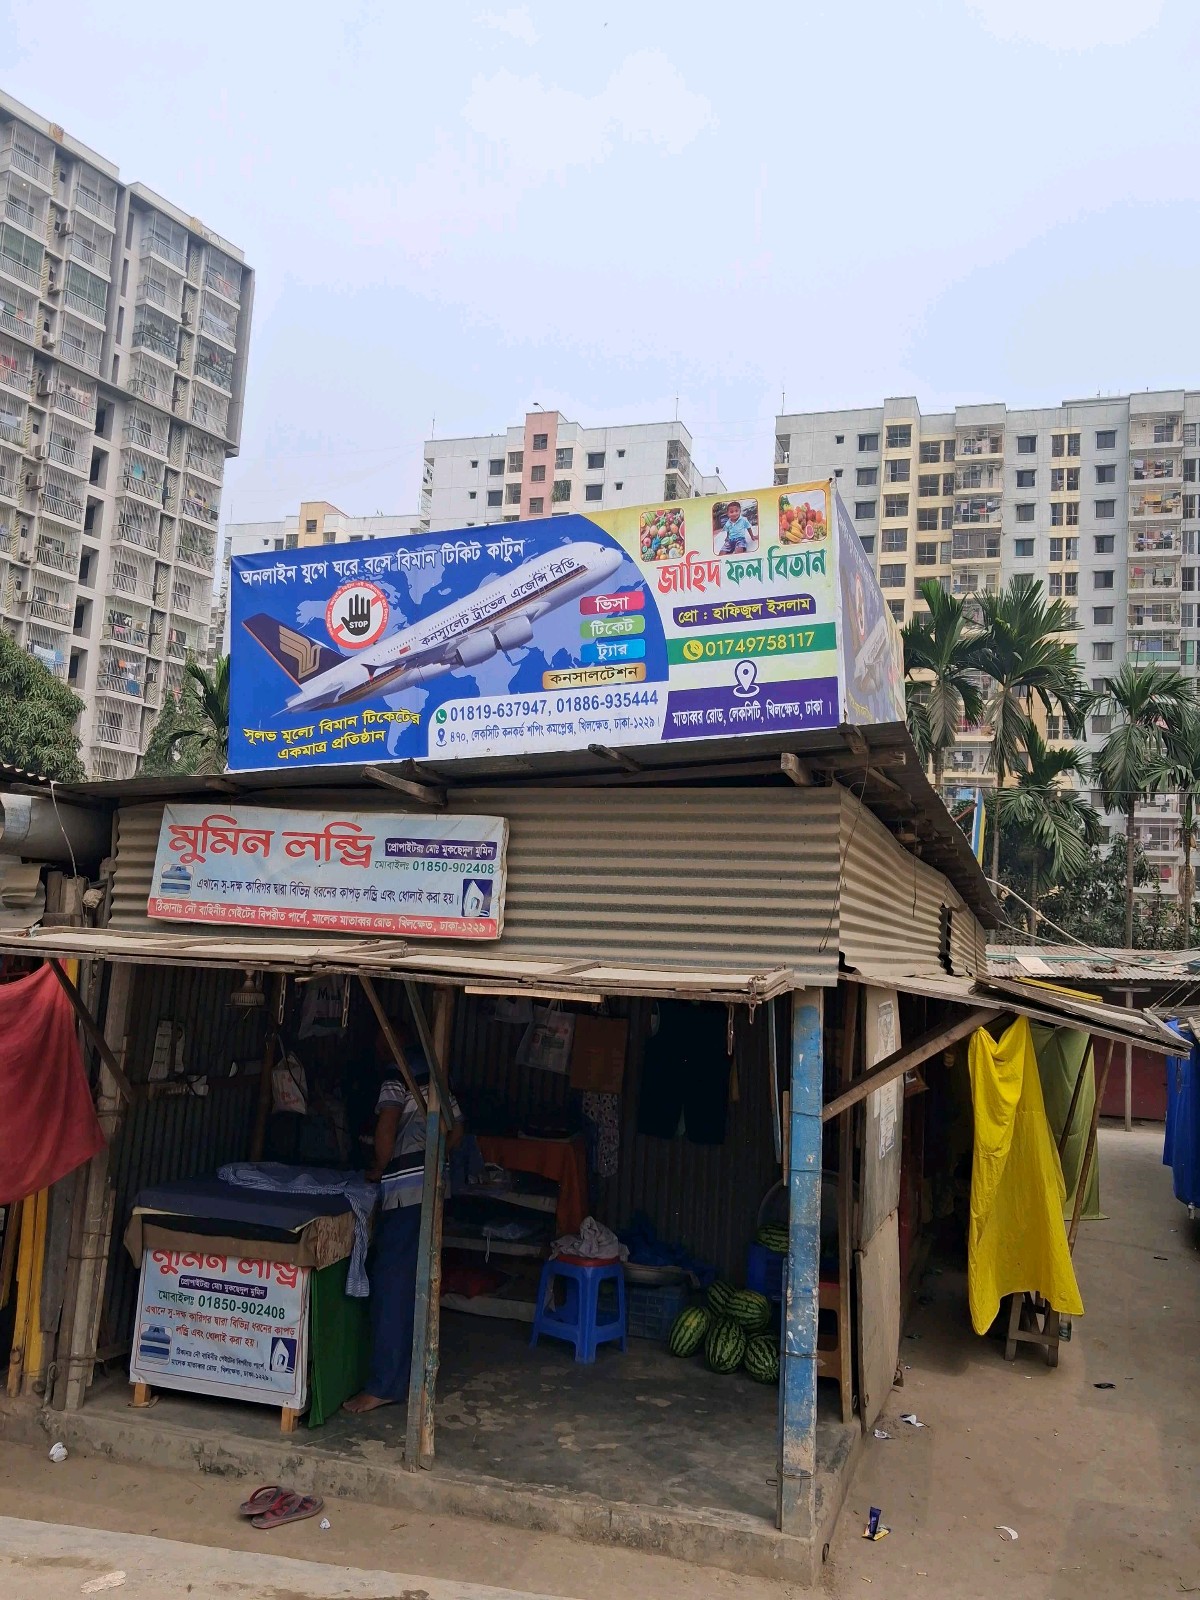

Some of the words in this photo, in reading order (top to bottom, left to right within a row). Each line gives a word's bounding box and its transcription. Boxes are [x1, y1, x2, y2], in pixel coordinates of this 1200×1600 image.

[240, 562, 298, 586] অনলাইন
[301, 560, 329, 584] যুগে
[332, 558, 360, 577] ঘরে
[363, 555, 392, 572] বসে
[396, 547, 436, 571] বিমান
[440, 540, 482, 565] টিকিট
[485, 536, 526, 563] কাটুন
[657, 550, 721, 594] জাহিদ
[726, 558, 763, 586] ফল
[768, 545, 827, 581] বিতান
[420, 614, 470, 646] কনস্যুলেট
[470, 593, 508, 622] ট্রাভেল
[511, 572, 547, 599] এজেন্সি
[595, 596, 630, 612] ভিসা
[766, 598, 811, 614] ইসলাম
[349, 620, 368, 628] STOP
[590, 618, 635, 636] টিকেট
[706, 632, 815, 656] 01749758117
[548, 666, 639, 684] কনসালটেশন
[450, 700, 552, 722] 01819-637947,
[556, 690, 659, 713] 01886-935444
[672, 710, 703, 726] মাতাব্বর
[706, 708, 727, 726] রোড,
[729, 700, 764, 723] লেকসিটি,
[804, 698, 823, 716] ঢাকা
[319, 719, 358, 735] বিমান
[362, 708, 421, 725] টিকেটের
[472, 725, 500, 741] লেকসিটি
[502, 722, 525, 738] কনকর্ড
[527, 721, 544, 737] শপিং
[277, 741, 327, 760] একমাত্র
[331, 728, 386, 749] প্রতিষ্ঠান
[168, 814, 275, 864] মুমিন
[282, 821, 375, 869] লন্ড্রি
[475, 843, 494, 858] মুমিন
[412, 860, 494, 874] 01850-902408
[197, 878, 219, 891] এখানে
[245, 879, 271, 895] কারিগর
[273, 882, 287, 896] দ্বারা
[290, 881, 310, 899] বিভিন্ন
[313, 886, 337, 898] ধরনের
[339, 887, 361, 903] কাপড়
[381, 889, 396, 902] এবং
[399, 888, 424, 904] ধোলাই
[426, 891, 441, 904] করা
[443, 893, 455, 905] হয়
[258, 908, 286, 920] বিপরীত
[312, 912, 338, 924] মালেক
[340, 915, 372, 927] মাতাব্বর
[440, 921, 486, 933] ঢাকা-১২২৯
[158, 1290, 194, 1305] মোবাইলঃ
[198, 1294, 285, 1320] 01850-902408
[191, 1329, 204, 1340] এবং
[229, 1335, 243, 1345] করা
[274, 1326, 296, 1338] কাপড়
